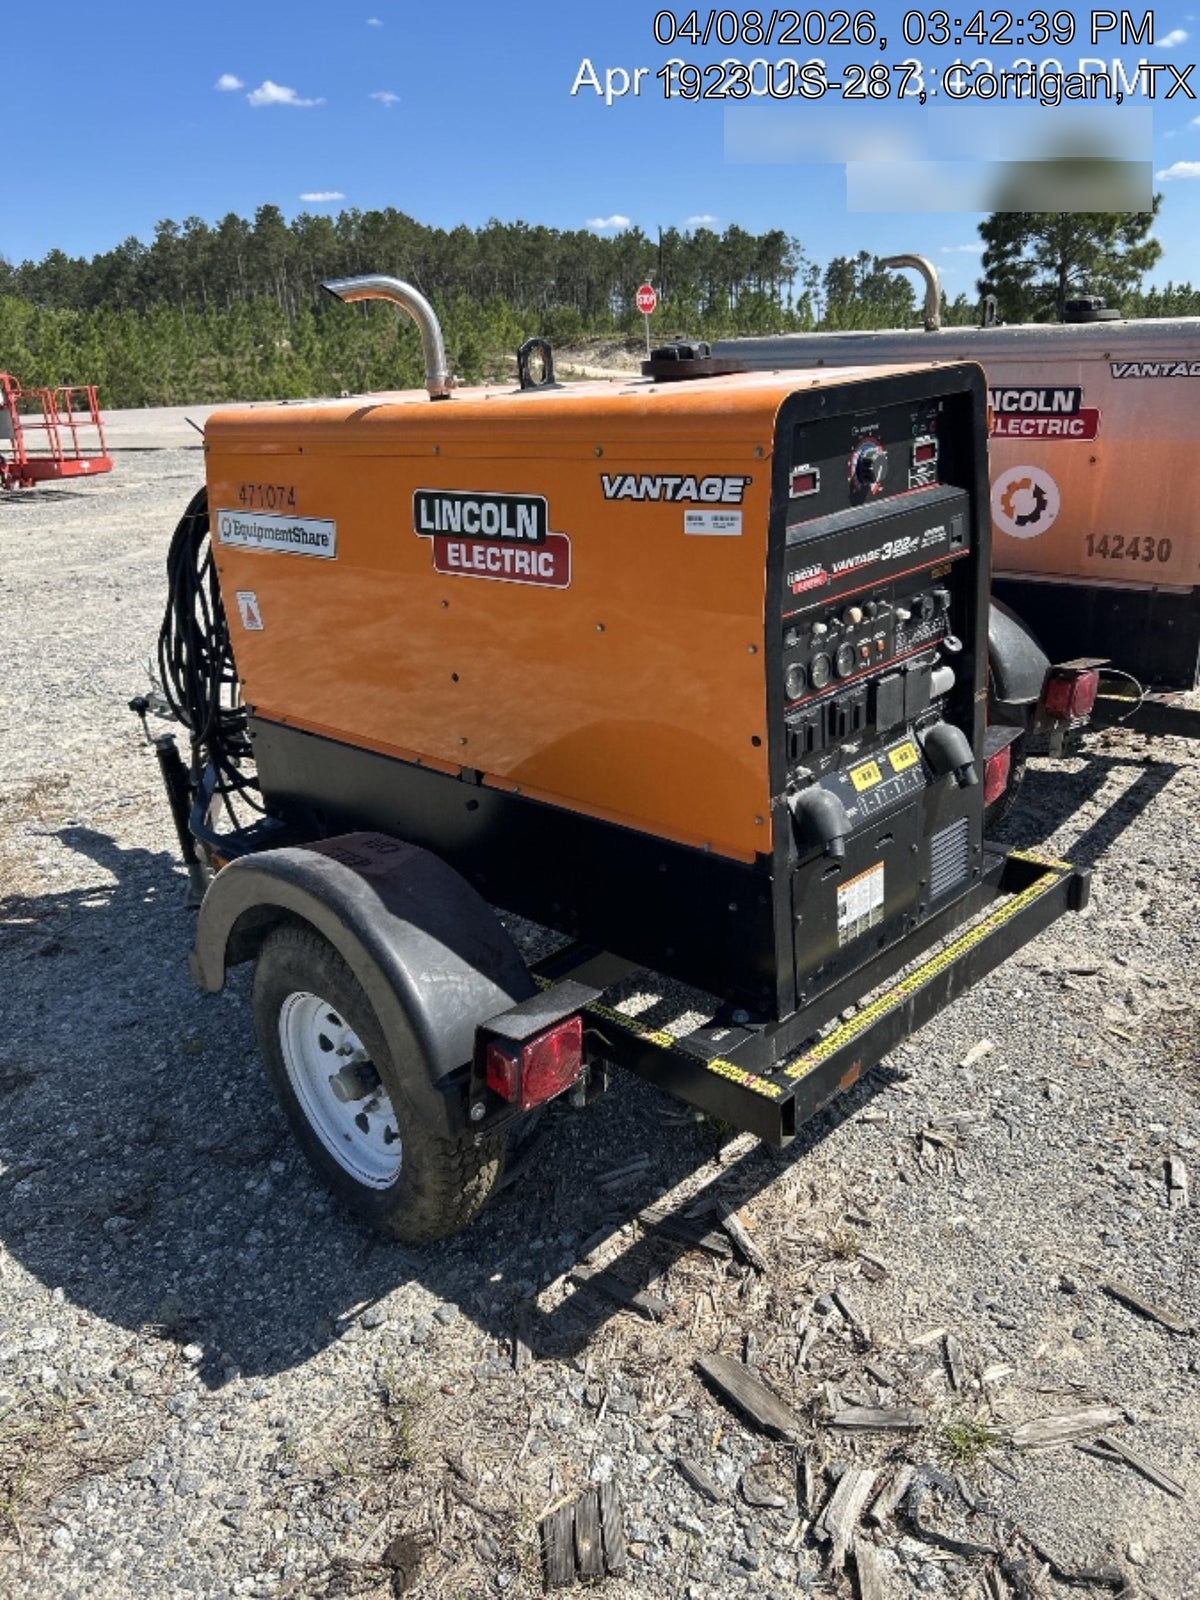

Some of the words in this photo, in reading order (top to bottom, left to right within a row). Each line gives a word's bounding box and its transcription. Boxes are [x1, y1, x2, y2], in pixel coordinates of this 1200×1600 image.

[993, 418, 1085, 435] LECTRIC
[239, 484, 297, 509] 471074
[602, 475, 746, 502] VANTAGE
[233, 518, 331, 547] EquipmentShare
[420, 498, 538, 540] LINCOLN
[447, 541, 555, 578] ELECTRIC
[1086, 534, 1172, 562] 142430
